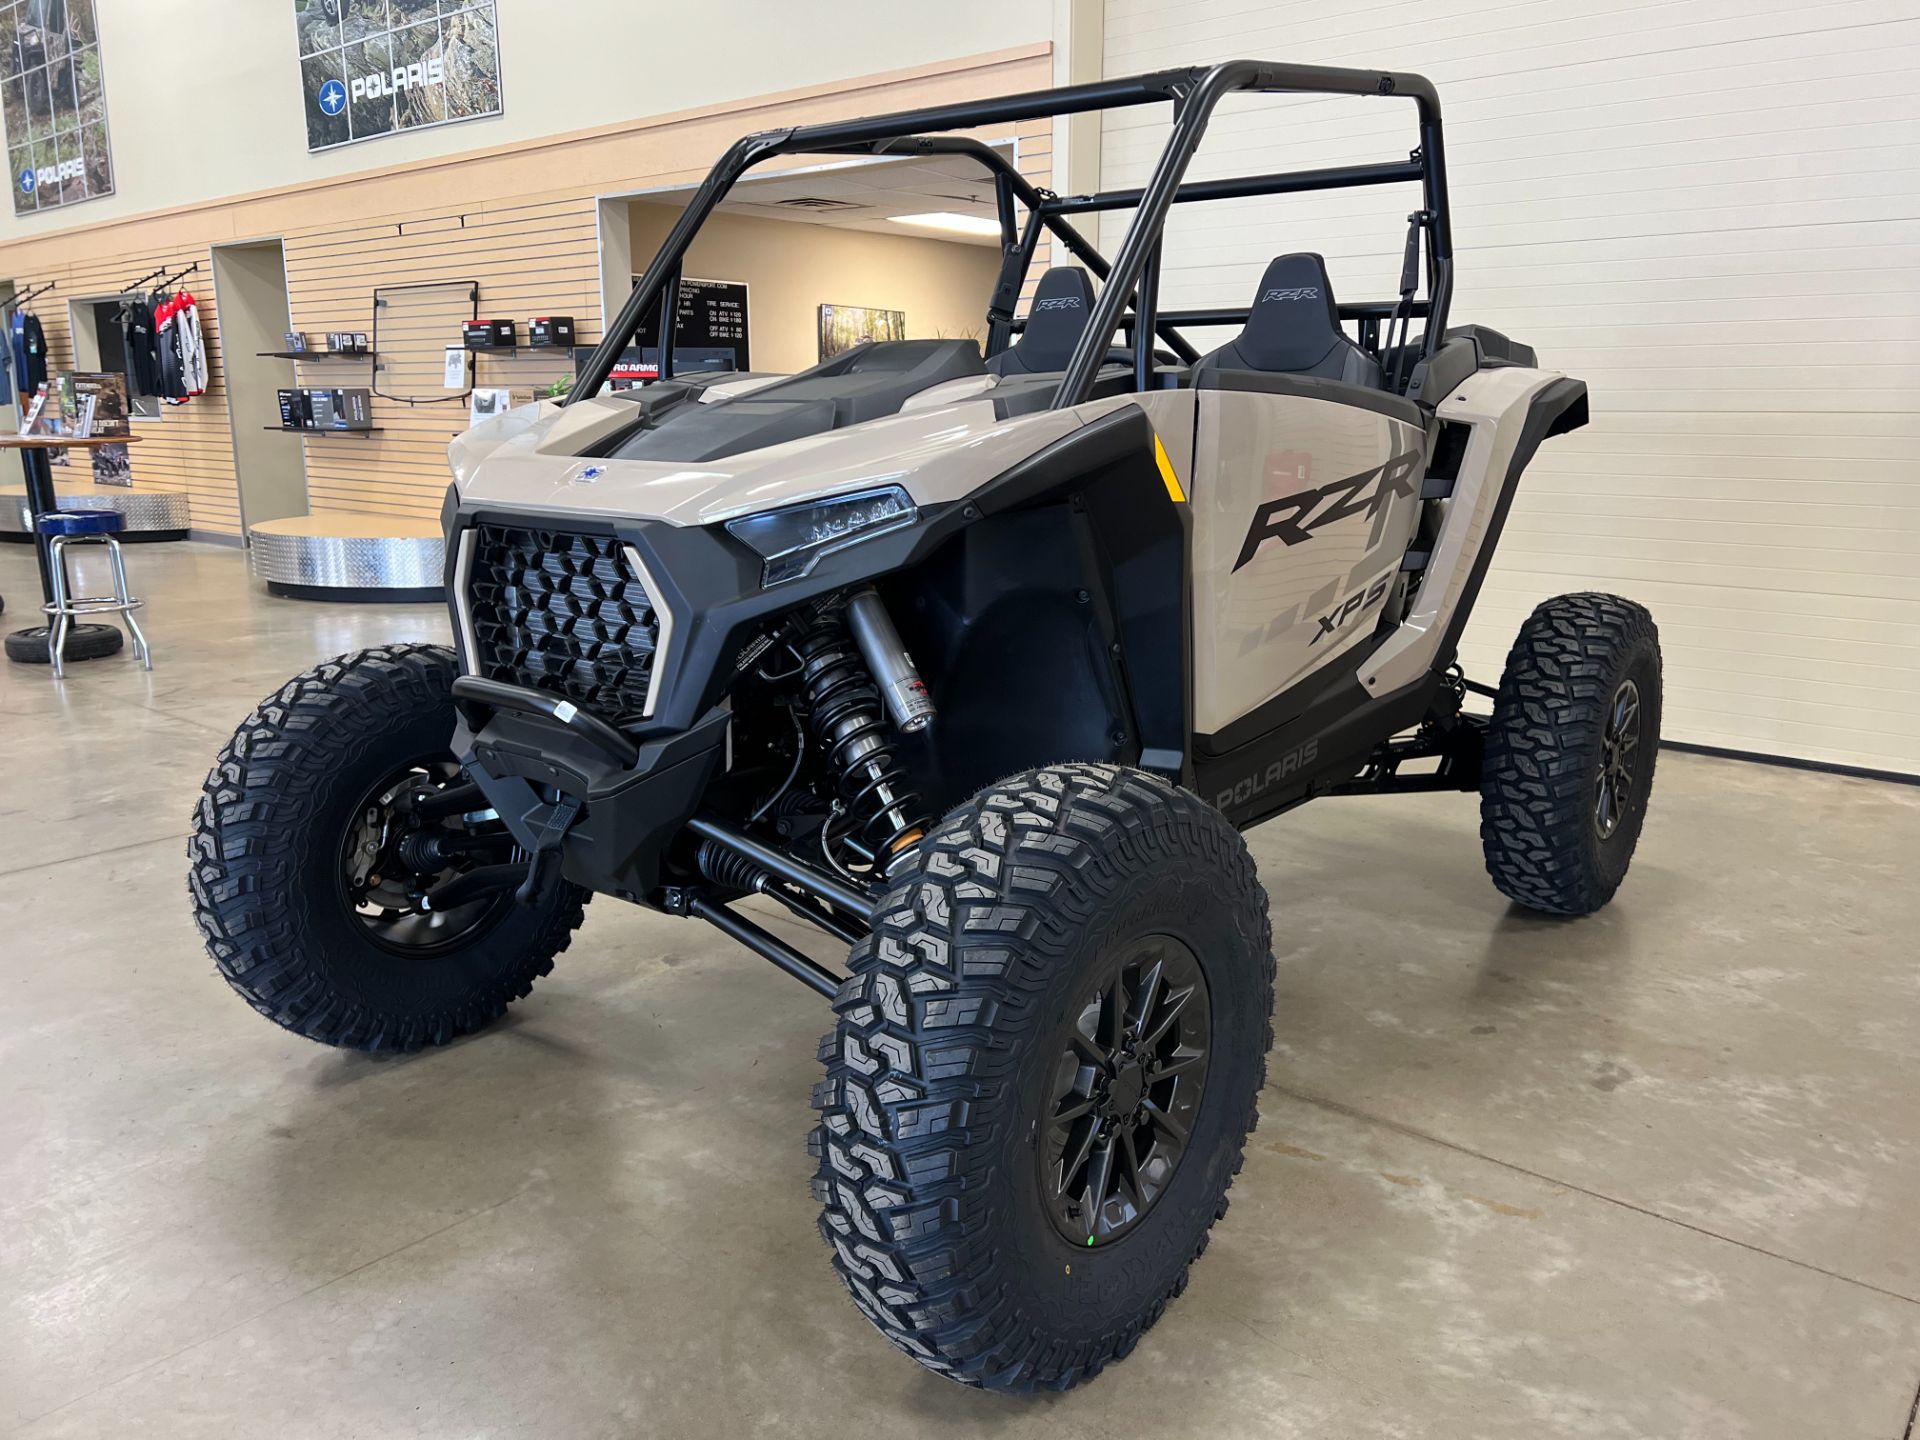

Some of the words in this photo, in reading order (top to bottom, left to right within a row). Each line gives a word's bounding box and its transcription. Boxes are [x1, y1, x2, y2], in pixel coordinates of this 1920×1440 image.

[351, 57, 443, 104] POLARIS
[36, 157, 85, 186] POLARIS
[1035, 296, 1081, 312] RZR
[1262, 287, 1319, 303] RZR
[612, 363, 629, 372] RO
[629, 363, 659, 372] ARMO
[1230, 447, 1422, 574] RZR
[1216, 739, 1319, 810] POLARIS
